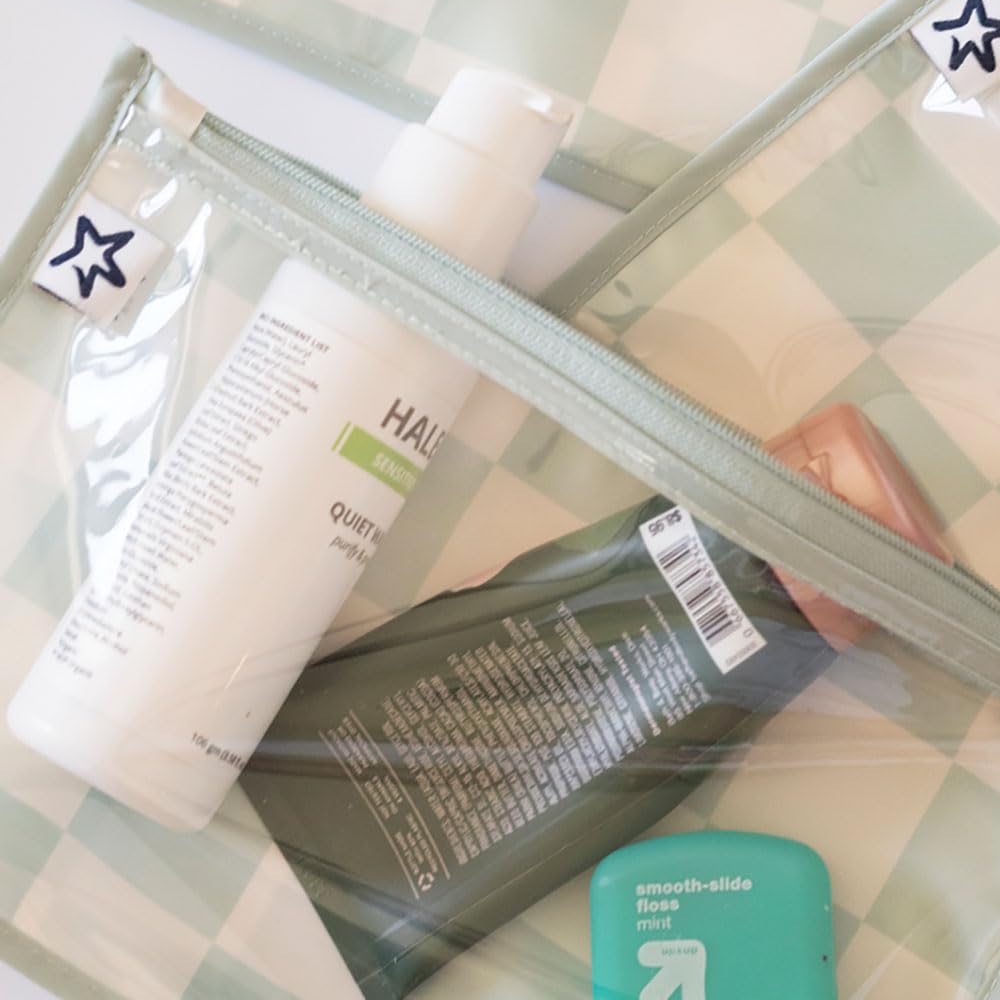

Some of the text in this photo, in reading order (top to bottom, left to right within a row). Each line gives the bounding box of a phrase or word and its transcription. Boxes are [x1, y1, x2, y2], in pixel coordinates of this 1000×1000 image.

[325, 499, 376, 540] QUIET
[637, 877, 752, 896] smooth-slide
[637, 898, 680, 913] floss
[637, 915, 671, 930] mint
